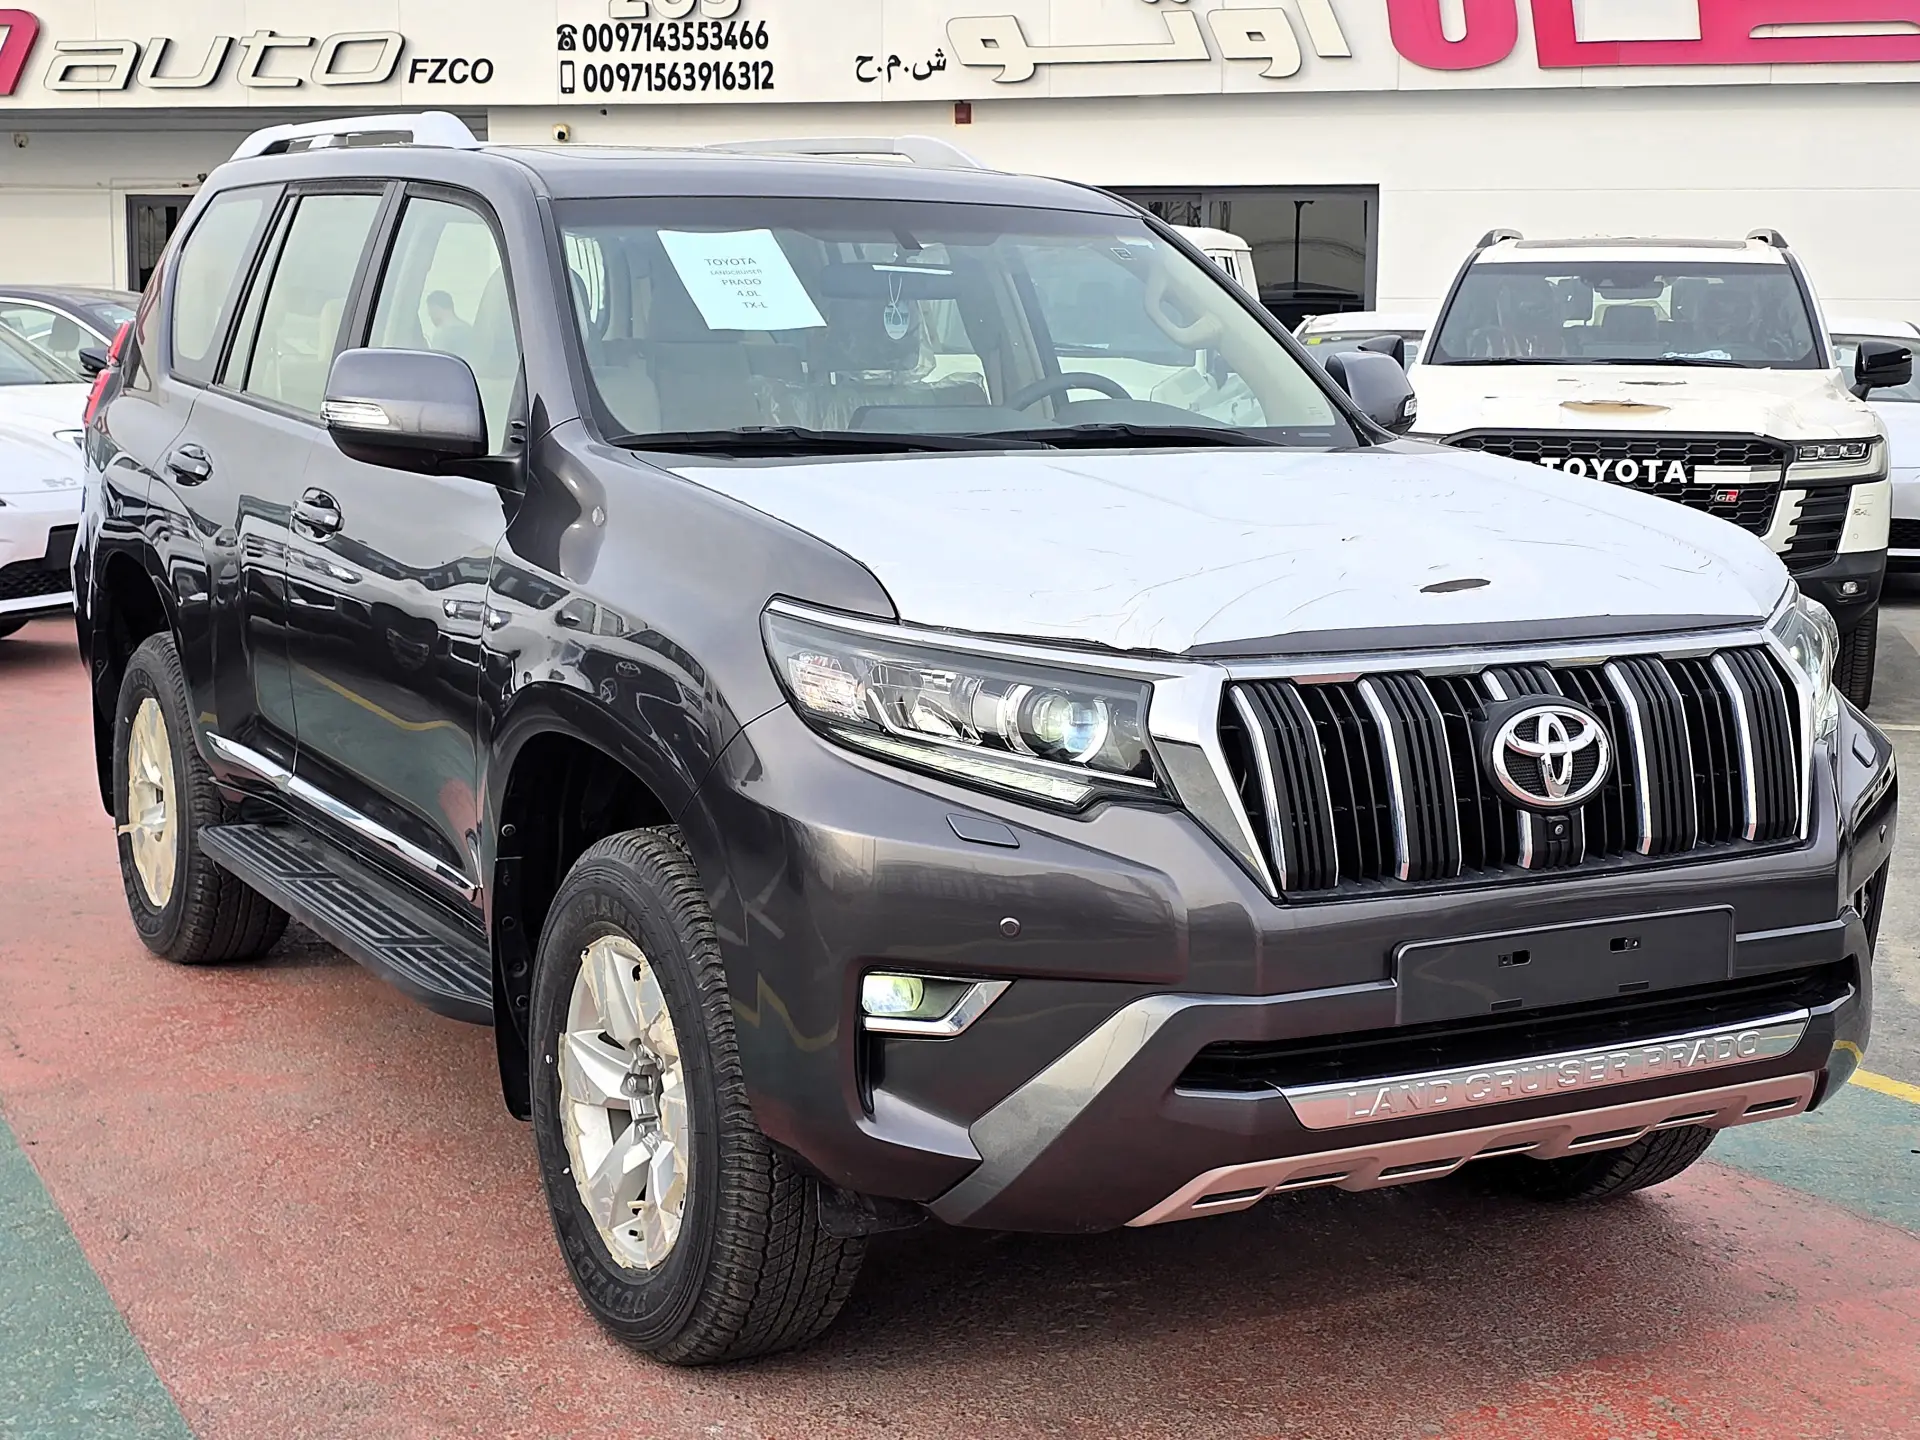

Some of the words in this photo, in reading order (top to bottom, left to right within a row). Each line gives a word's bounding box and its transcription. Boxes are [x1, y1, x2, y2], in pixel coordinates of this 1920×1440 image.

[583, 21, 769, 52] 0097143553466
[43, 30, 407, 91] auto
[408, 58, 494, 84] FZCO
[583, 61, 774, 92] 00971563916312
[703, 257, 757, 266] TOYOTA
[709, 268, 763, 276] LANDCRUISER
[721, 278, 762, 286] PRADO
[1540, 457, 1687, 484] TOYOTA
[1715, 490, 1739, 502] GR
[1347, 1079, 1452, 1119] LAND
[1465, 1052, 1631, 1102] CRUISER
[1642, 1030, 1760, 1074] PRADO
